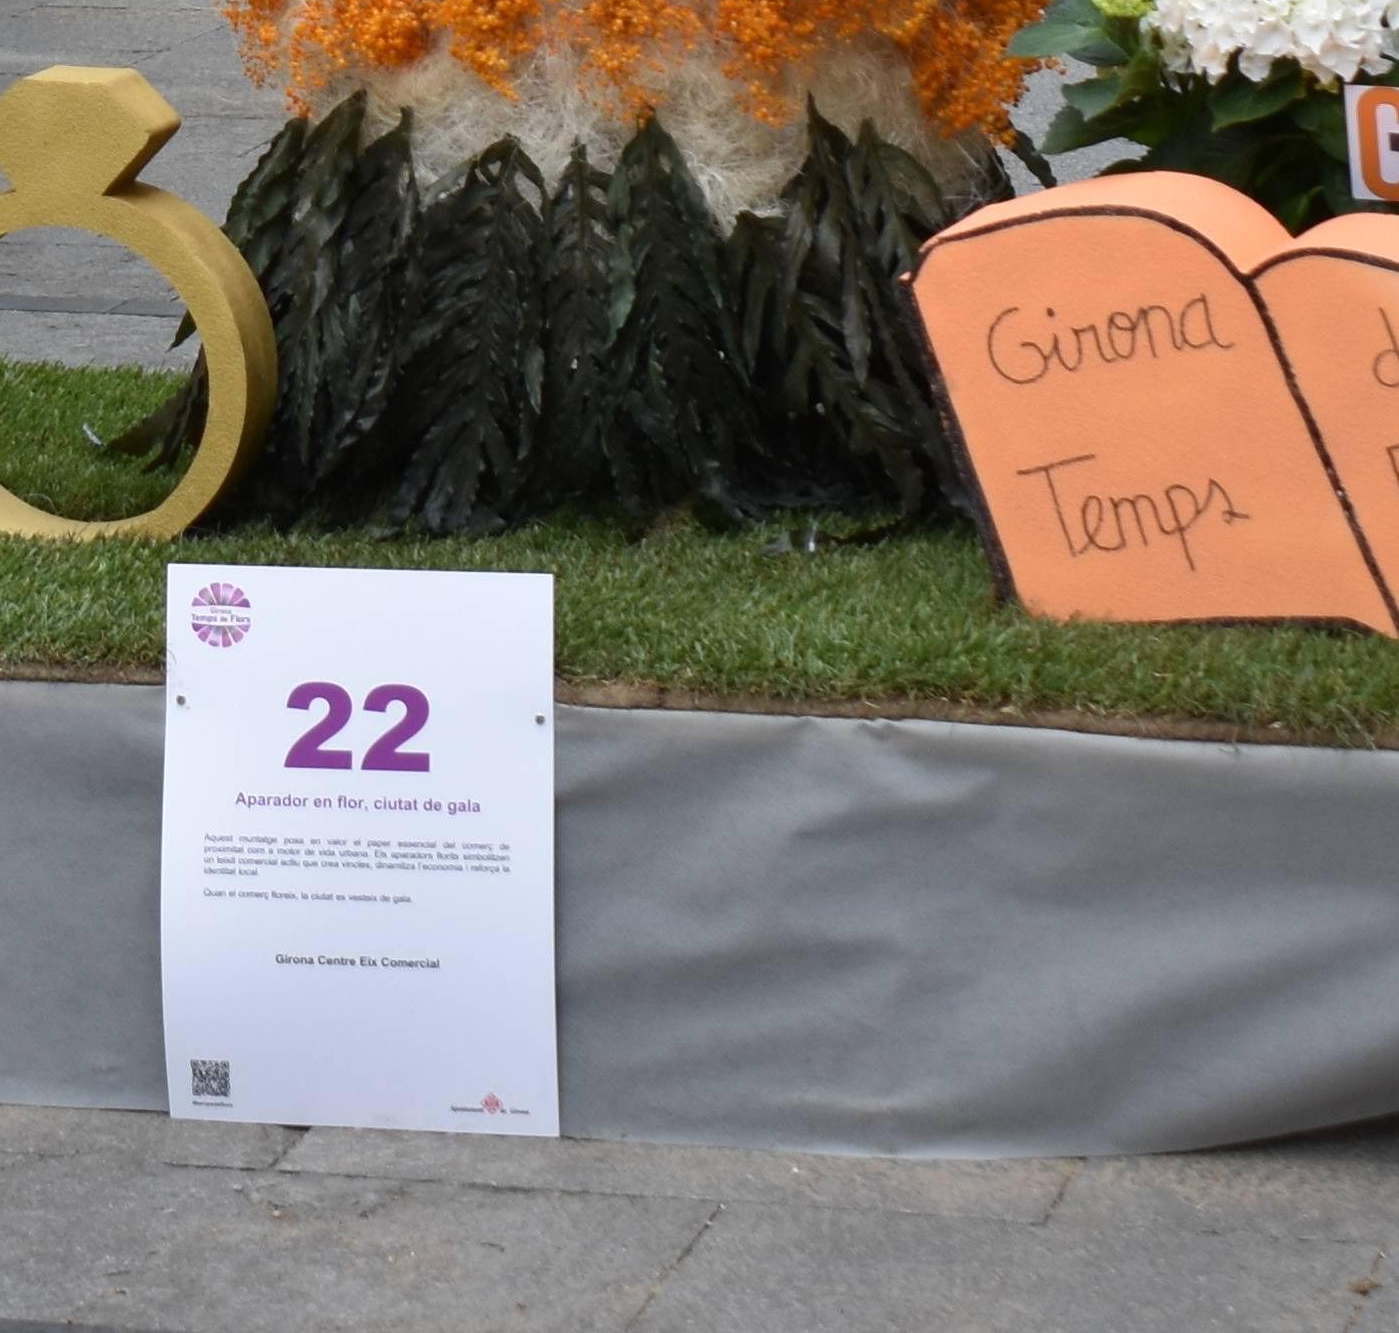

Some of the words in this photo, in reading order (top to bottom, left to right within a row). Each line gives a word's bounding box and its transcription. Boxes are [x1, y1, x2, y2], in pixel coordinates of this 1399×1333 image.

[986, 293, 1236, 385] Girona
[1016, 453, 1250, 572] Temps
[284, 680, 431, 773] 22
[235, 792, 308, 809] Aparador
[313, 797, 332, 809] en
[337, 795, 368, 811] flor,
[373, 797, 418, 811] ciutat
[423, 798, 442, 812] de
[447, 799, 481, 815] gala
[204, 833, 233, 842] Aquest
[239, 836, 278, 845] muntatge
[327, 837, 348, 845] valor
[203, 888, 226, 897] Quan
[275, 953, 314, 965] Girona
[317, 954, 355, 966] Centre
[359, 956, 377, 967] Eix
[381, 957, 440, 969] Comercial
